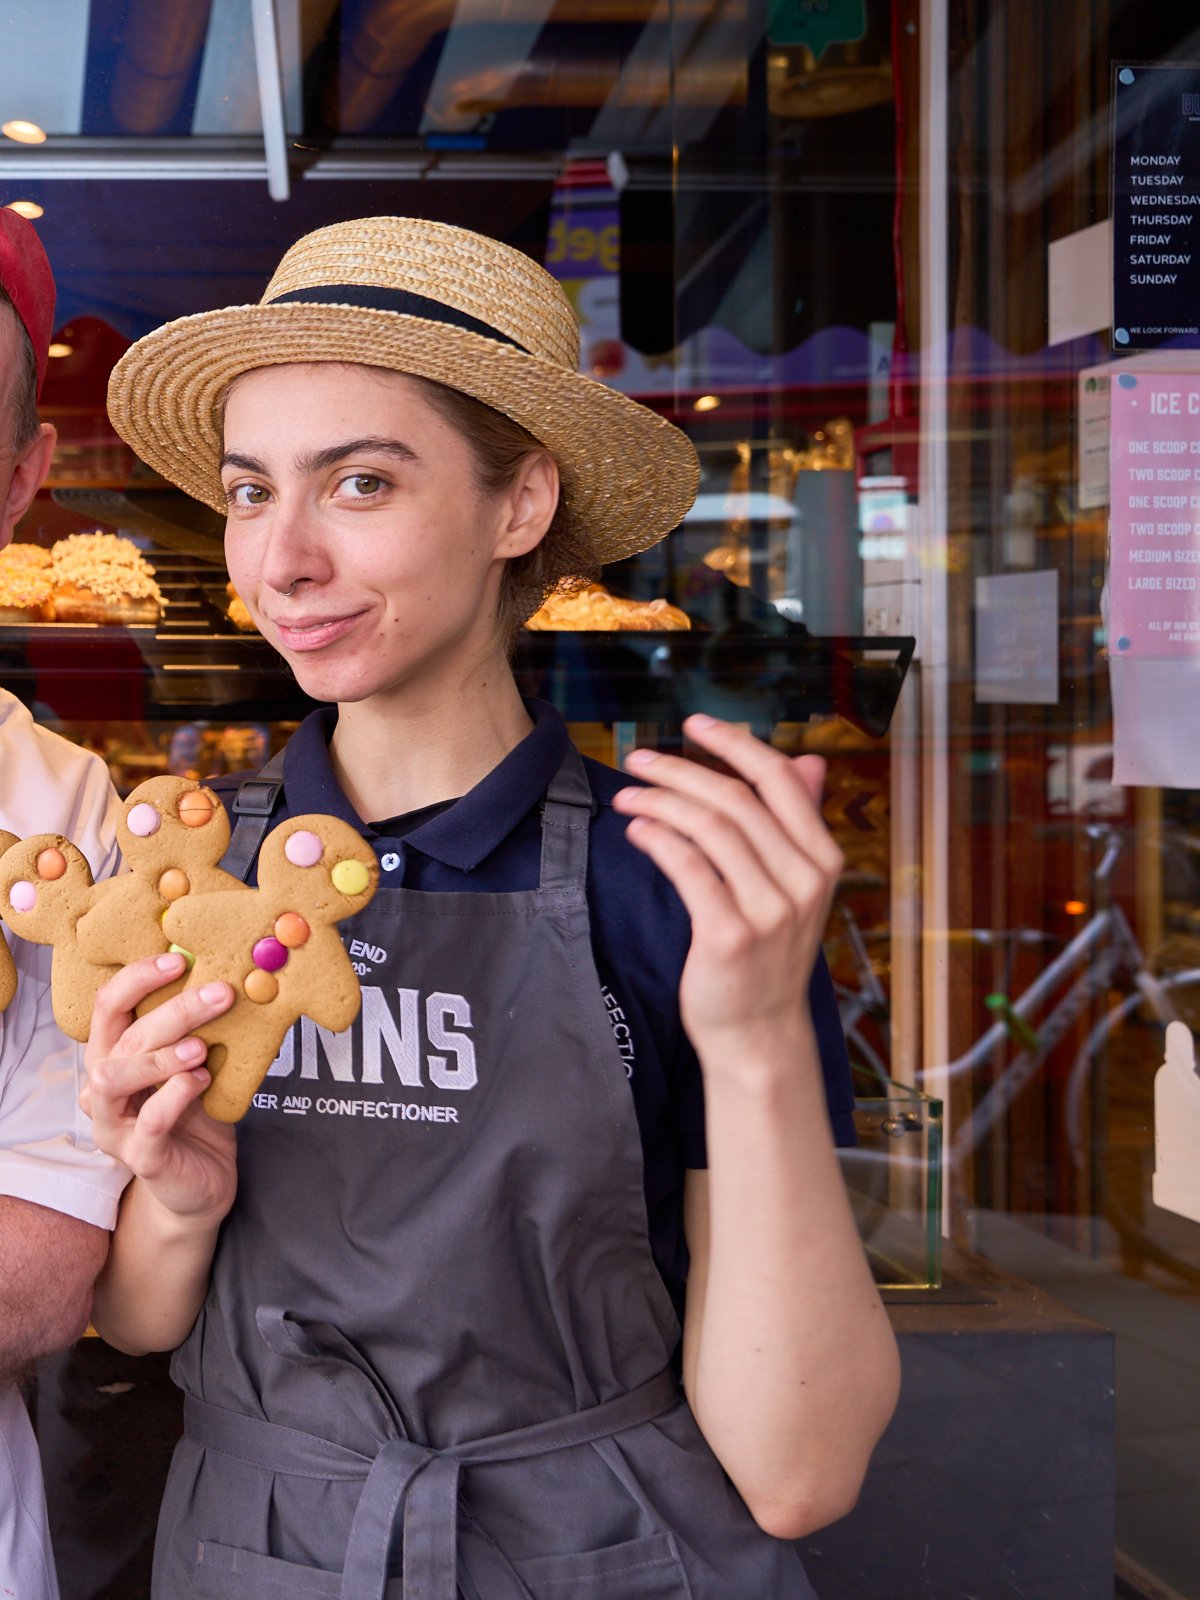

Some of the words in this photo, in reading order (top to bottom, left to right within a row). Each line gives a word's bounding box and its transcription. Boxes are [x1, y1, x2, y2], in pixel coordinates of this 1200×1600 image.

[1130, 155, 1181, 166] MONDAY
[1130, 175, 1184, 186] TUESDAY
[1130, 195, 1200, 206] WEDNESDAY
[1130, 215, 1193, 226] THURSDAY
[1130, 234, 1171, 245] FRIDAY
[1130, 254, 1191, 265] SATURDAY
[1130, 274, 1178, 285] SUNDAY
[1130, 327, 1142, 335] WE
[1143, 327, 1163, 335] LOOK
[1164, 327, 1199, 335] FORWARD
[1150, 391, 1181, 415] ICE
[1128, 441, 1150, 454] ONE
[1152, 441, 1188, 455] SCOOP
[1128, 468, 1153, 481] TWO
[1157, 468, 1192, 481] SCOOP
[1128, 495, 1151, 508] ONE
[1153, 495, 1188, 508] SCOOP
[1128, 522, 1154, 535] TWO
[1157, 522, 1192, 535] SCOOP
[1129, 550, 1171, 563] MEDIUM
[1128, 577, 1163, 590] LARGE
[1166, 577, 1196, 590] SIZED
[349, 939, 388, 964] END
[352, 961, 367, 976] 20
[267, 985, 478, 1090] NNS
[252, 1093, 278, 1110] KER
[282, 1096, 312, 1110] AND
[315, 1097, 460, 1123] CONFECTIONER
